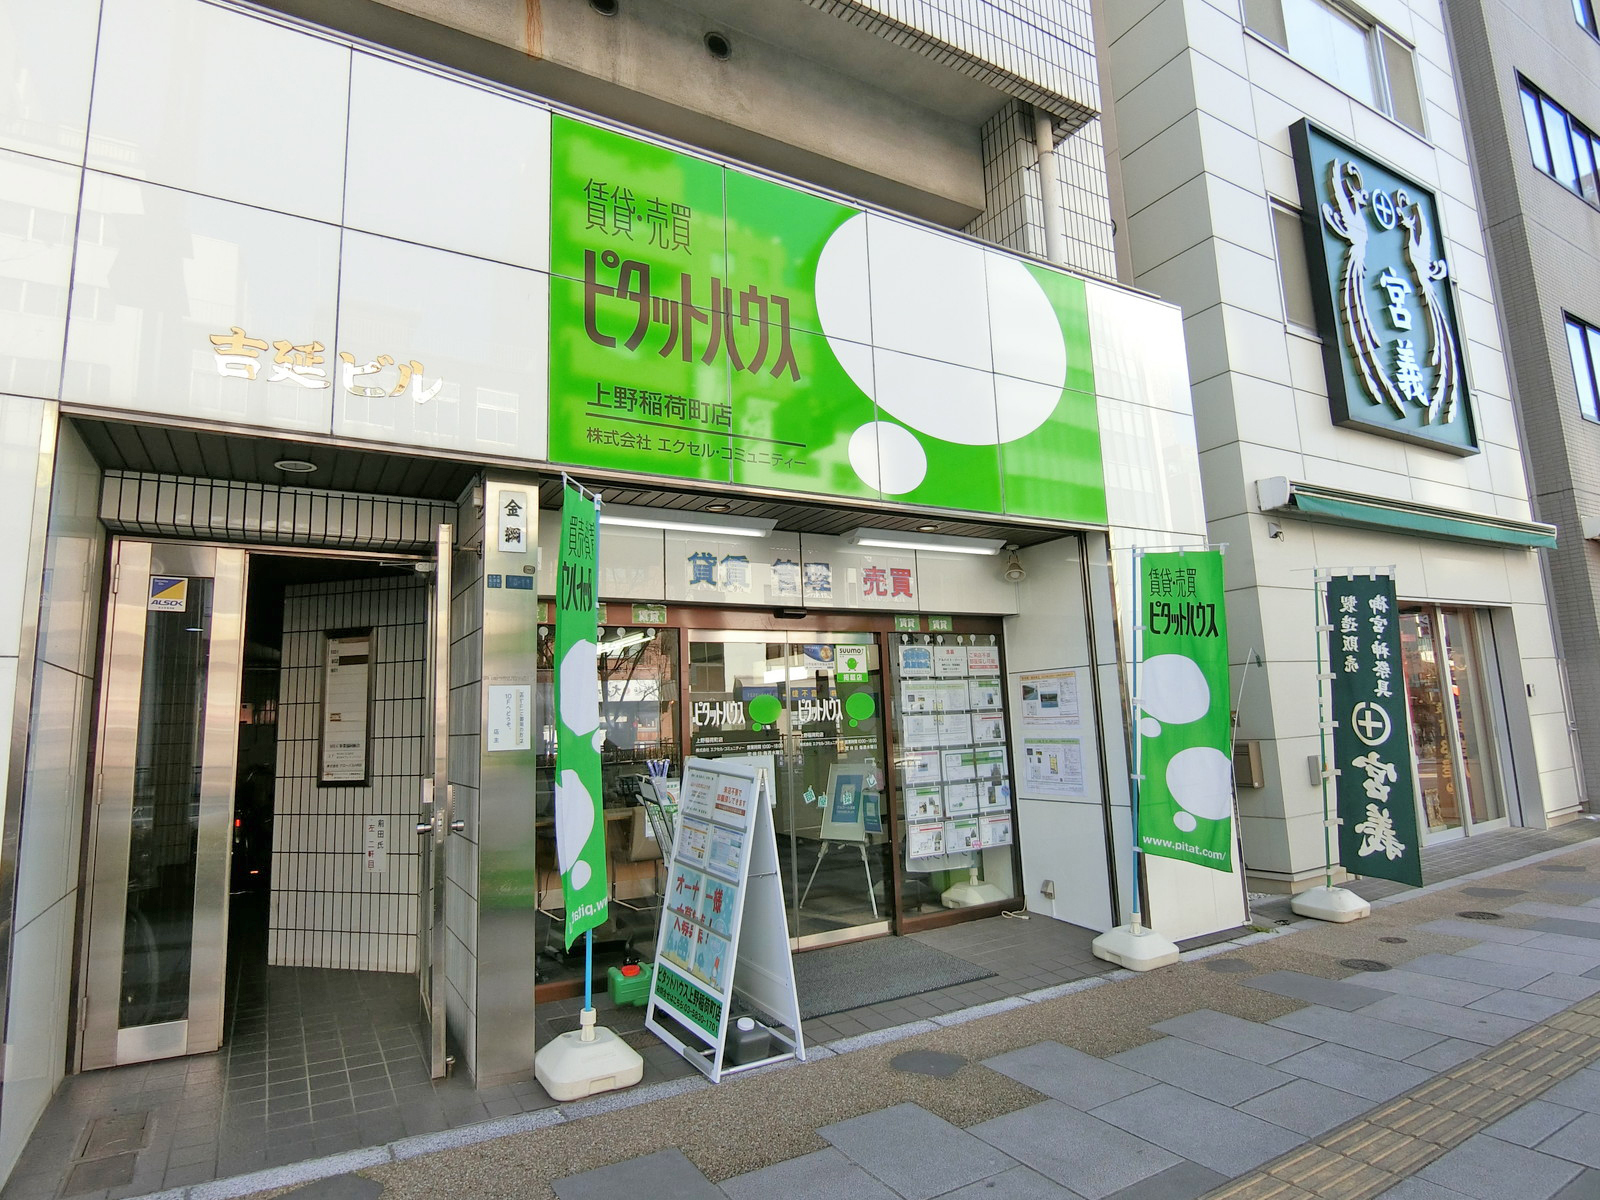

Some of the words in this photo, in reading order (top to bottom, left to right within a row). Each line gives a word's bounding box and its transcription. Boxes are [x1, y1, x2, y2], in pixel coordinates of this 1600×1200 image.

[583, 178, 693, 256] 賃貸・売買
[583, 248, 801, 382] ピタットハウス
[1378, 266, 1431, 408] 宮義
[209, 326, 444, 405] 吉延ビル
[586, 382, 732, 428] 上野稲荷町店
[586, 426, 652, 452] 株式会社
[657, 437, 807, 469] エクセル・コミュニティー
[862, 565, 914, 598] 売買
[1148, 567, 1197, 598] 賃貸・売買
[150, 599, 183, 607] ALSOK
[1149, 600, 1219, 638] ピタットハウス
[694, 700, 746, 726] ピタットハウス
[798, 697, 844, 722] ピタットハウス
[1142, 835, 1227, 861] www.pitat.com/
